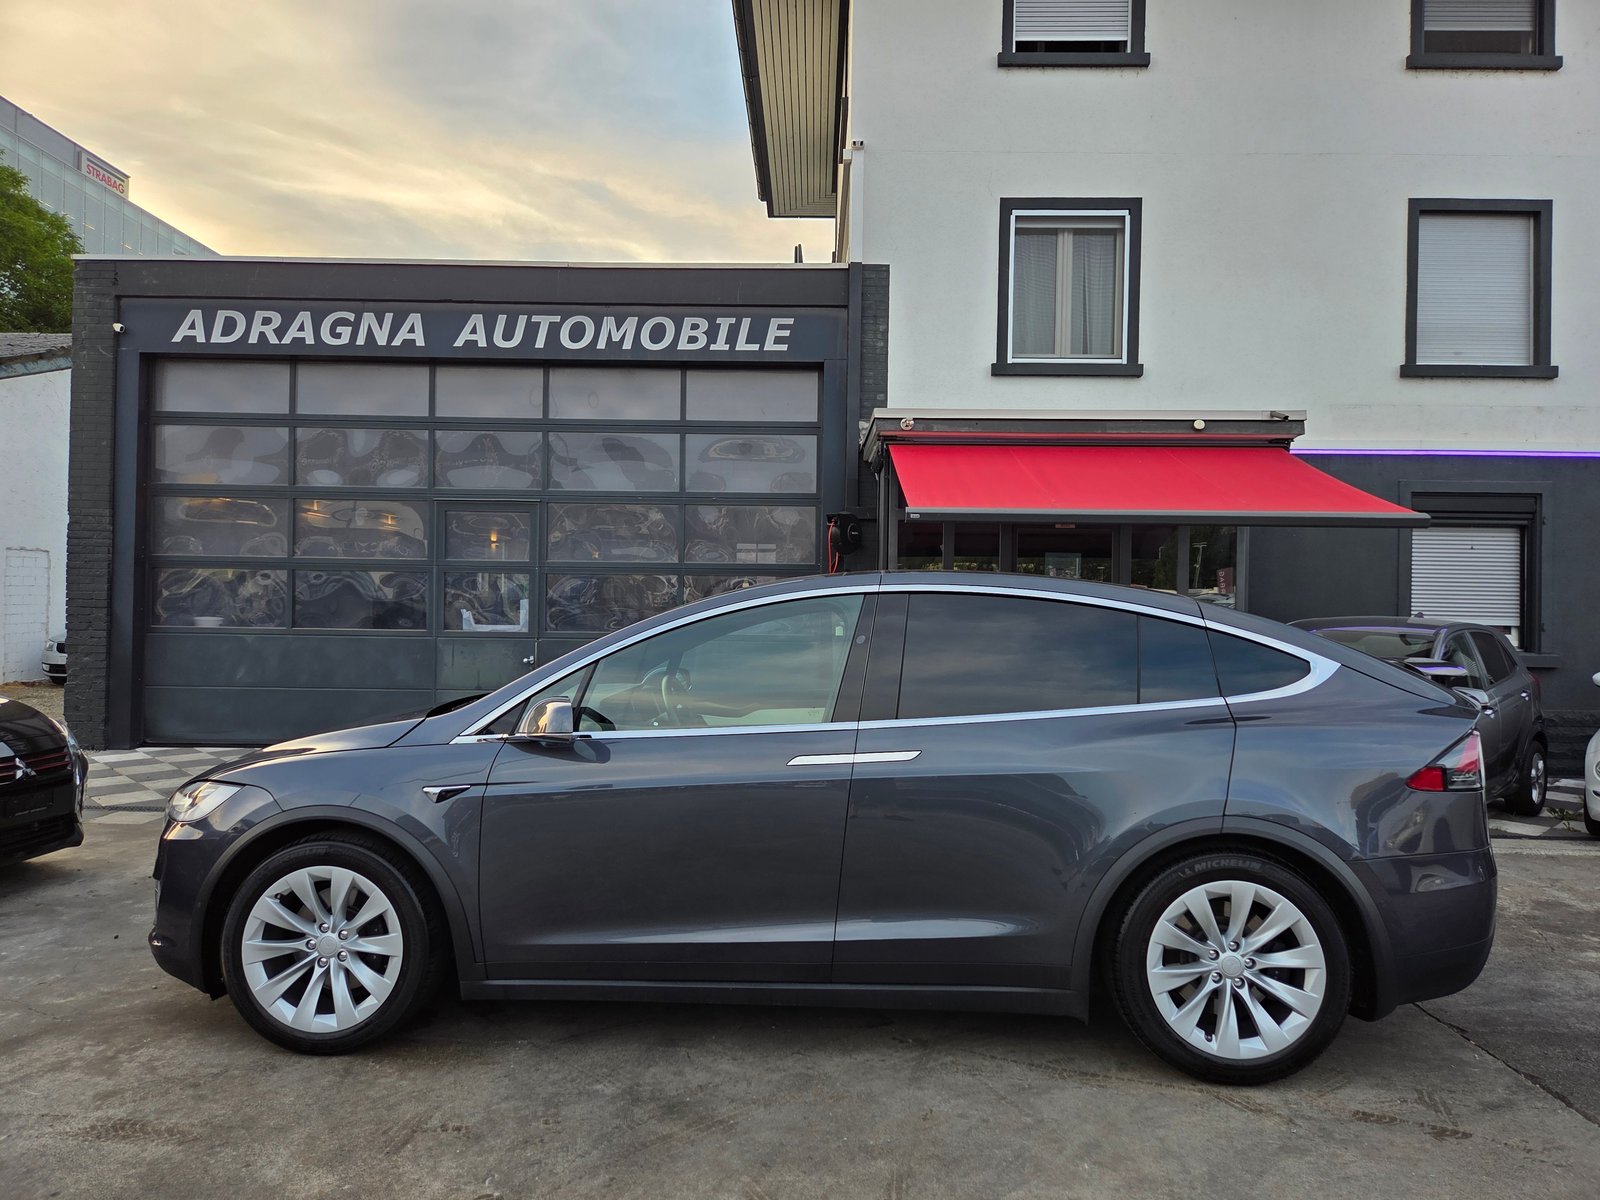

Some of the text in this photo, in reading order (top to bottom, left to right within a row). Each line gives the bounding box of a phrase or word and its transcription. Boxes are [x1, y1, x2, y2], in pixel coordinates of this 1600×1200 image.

[86, 163, 125, 194] STRABAG
[171, 309, 795, 352] ADRAGNA AUTOMOBILE
[1194, 858, 1262, 873] MICHELIN
